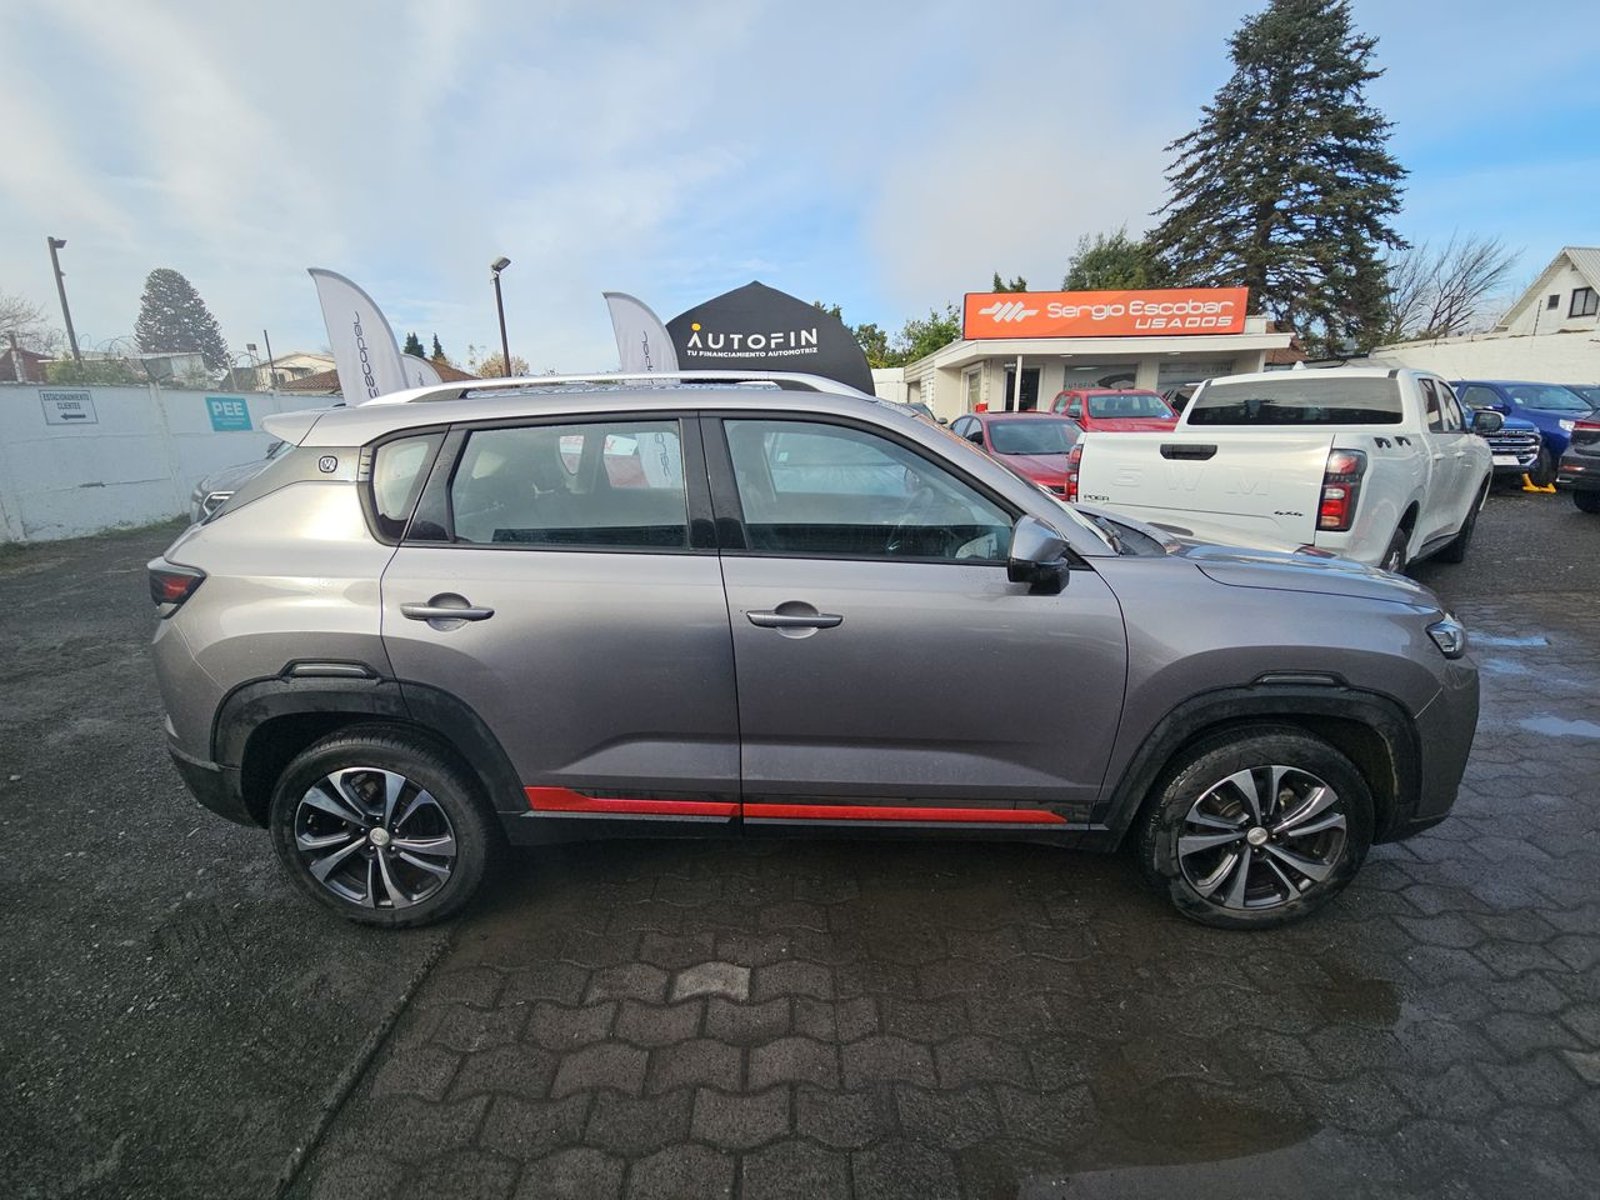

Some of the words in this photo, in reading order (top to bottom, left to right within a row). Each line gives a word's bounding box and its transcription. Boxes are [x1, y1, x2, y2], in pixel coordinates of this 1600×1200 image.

[1046, 302, 1125, 320] Sergio
[1128, 298, 1234, 315] Escobar
[1134, 316, 1233, 329] USADOS
[687, 328, 818, 349] AUTOFIN
[699, 350, 766, 359] FINANCIAMIENTO
[767, 347, 818, 358] AUTOMOTRIZ
[211, 401, 245, 416] PEE
